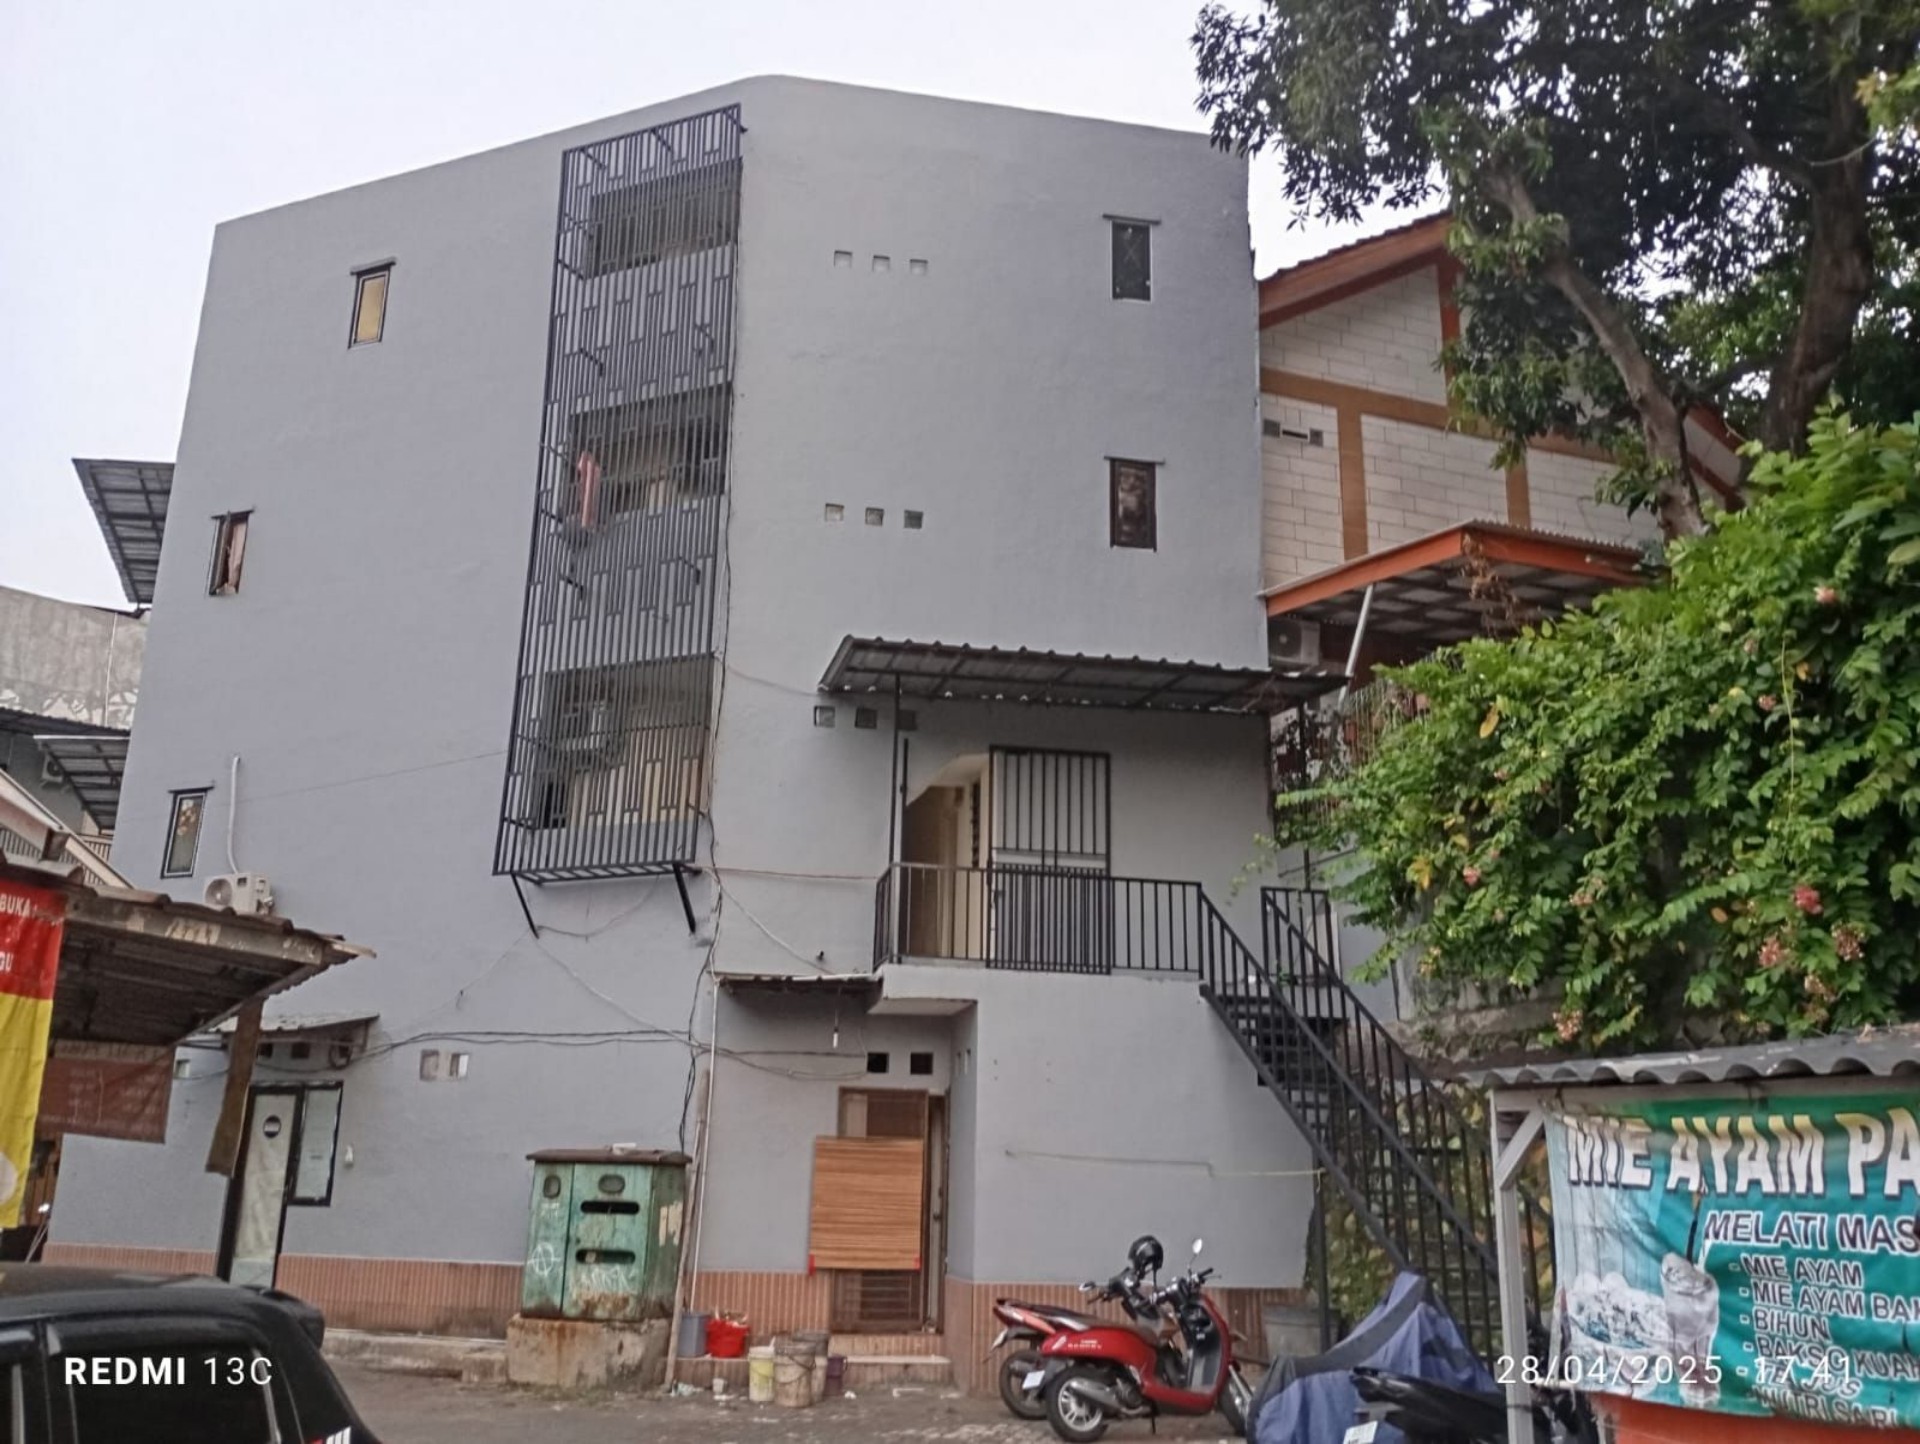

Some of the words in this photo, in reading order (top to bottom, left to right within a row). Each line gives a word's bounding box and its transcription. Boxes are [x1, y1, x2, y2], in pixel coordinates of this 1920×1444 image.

[1563, 1115, 1653, 1189] MIE
[1666, 1114, 1825, 1197] AYAM
[1704, 1211, 1828, 1249] MELATI
[1741, 1253, 1790, 1280] MIE
[1794, 1258, 1863, 1288] AYAM
[1753, 1281, 1794, 1308] MIE
[1799, 1287, 1865, 1318] AYAM
[1753, 1306, 1831, 1343] BIHUN
[1756, 1334, 1846, 1374] BAKSO
